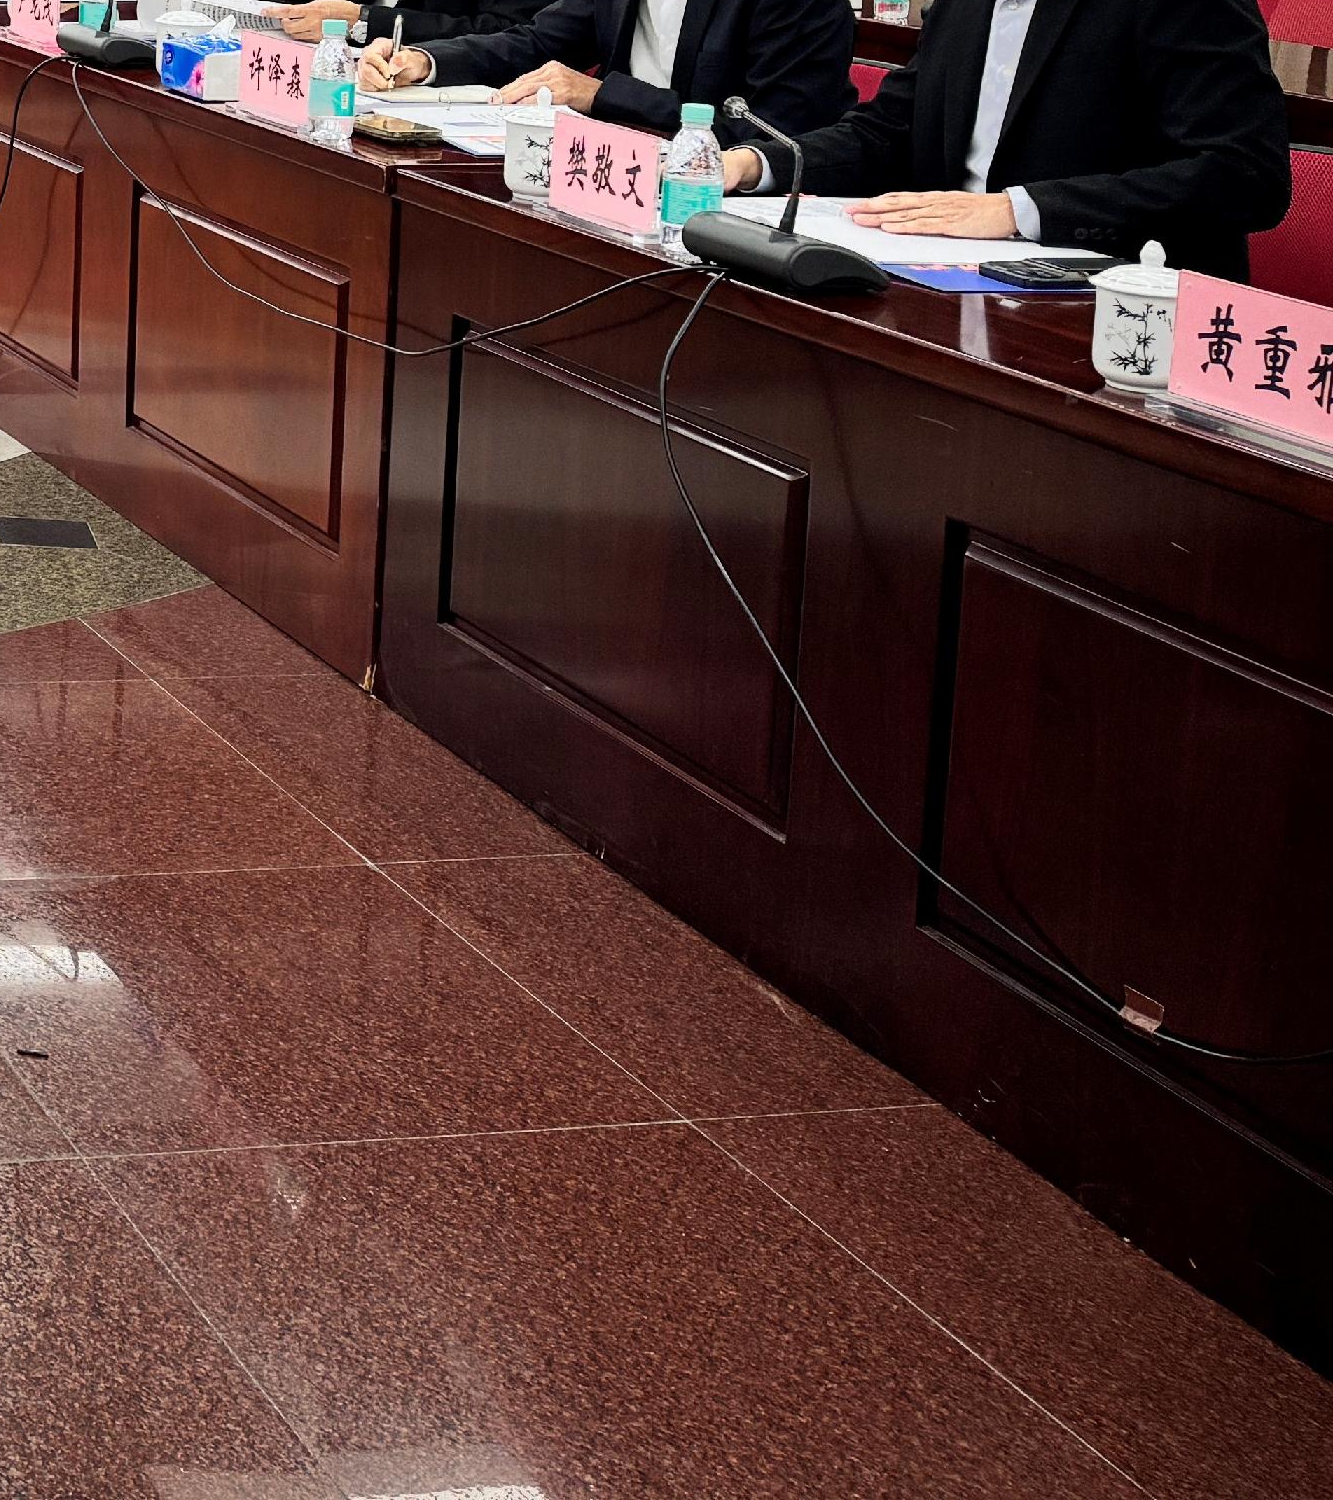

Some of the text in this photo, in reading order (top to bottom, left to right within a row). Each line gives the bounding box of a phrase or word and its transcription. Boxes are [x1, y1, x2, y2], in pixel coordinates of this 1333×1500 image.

[249, 47, 305, 100] 许泽森
[565, 135, 645, 208] 樊敬文
